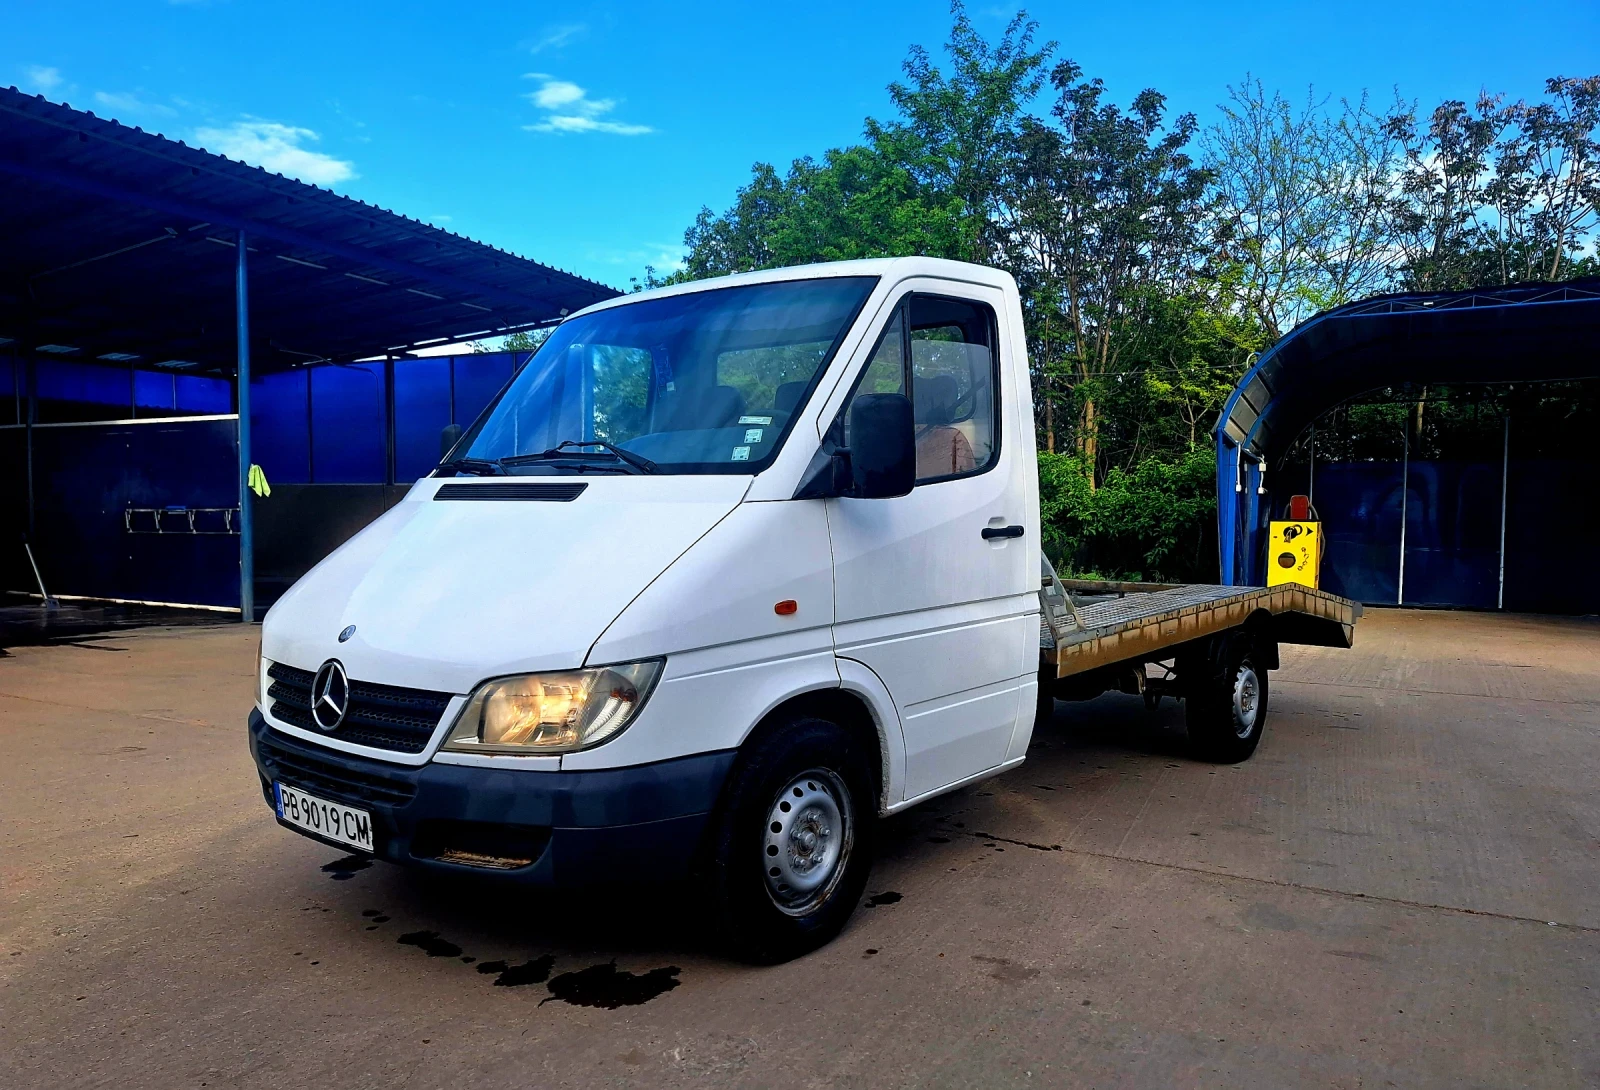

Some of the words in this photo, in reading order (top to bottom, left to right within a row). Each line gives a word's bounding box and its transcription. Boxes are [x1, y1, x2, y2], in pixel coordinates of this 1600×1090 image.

[281, 788, 300, 821] PB
[301, 797, 340, 835] 9019
[343, 811, 370, 845] CM
